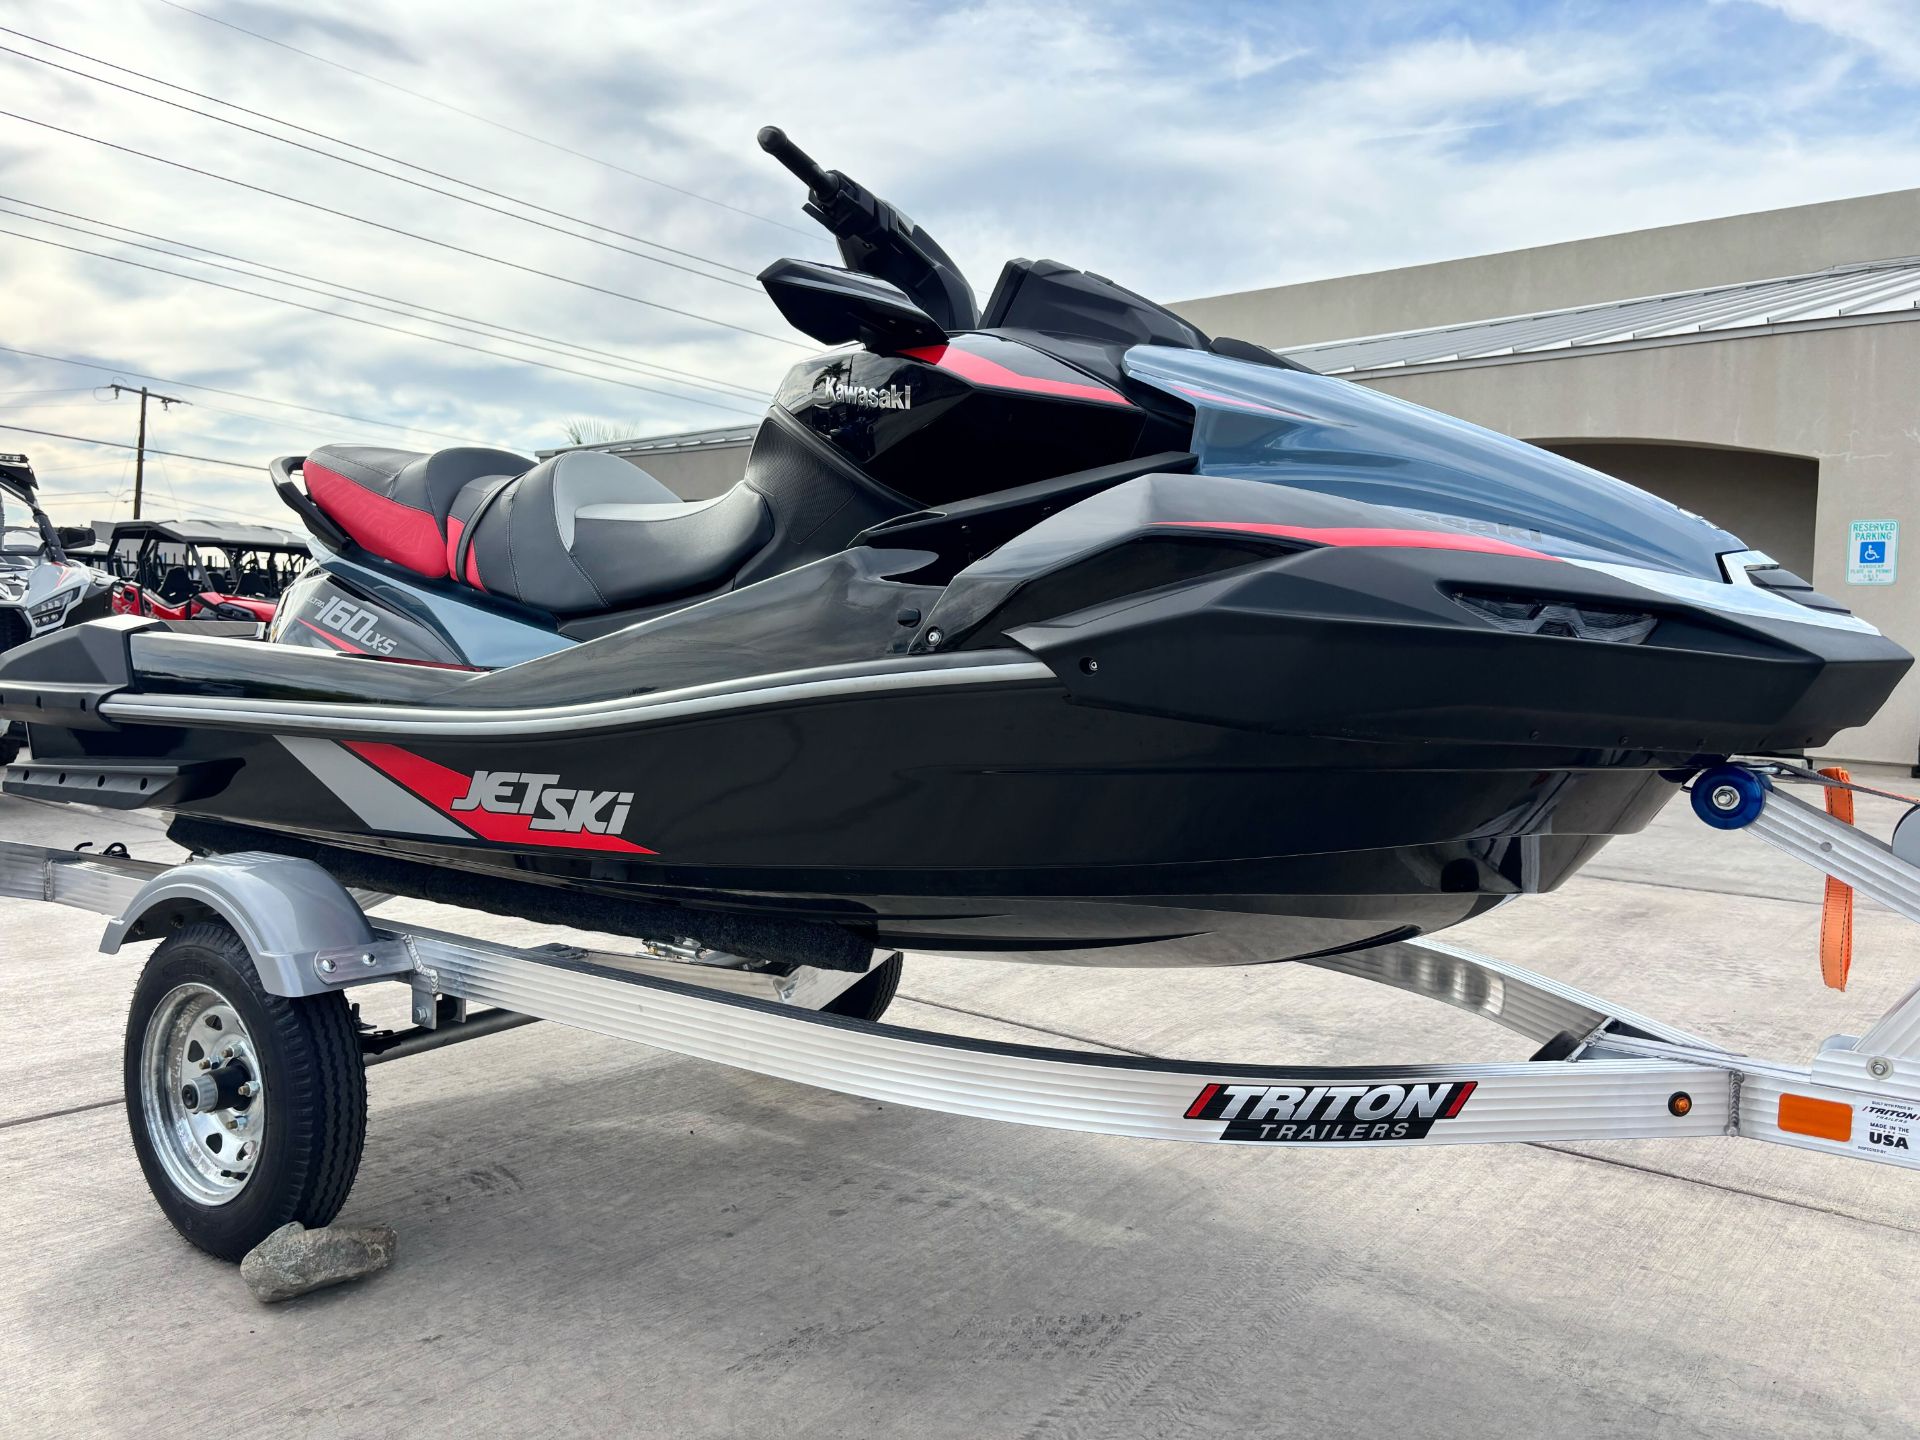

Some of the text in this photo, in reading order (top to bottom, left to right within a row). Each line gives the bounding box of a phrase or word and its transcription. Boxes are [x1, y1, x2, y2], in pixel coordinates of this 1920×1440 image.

[825, 376, 911, 410] Kawasaki
[1853, 523, 1895, 531] RESERVED
[1855, 532, 1892, 541] PARKING
[314, 595, 398, 655] 160 LX-S
[450, 770, 561, 815] JET
[1218, 1083, 1455, 1121] TRITON
[1869, 1106, 1917, 1120] TRITON
[1876, 1115, 1908, 1124] TRAILERS
[1258, 1122, 1410, 1140] TRAILERS
[1898, 1126, 1910, 1134] THE
[1869, 1132, 1909, 1150] USA
